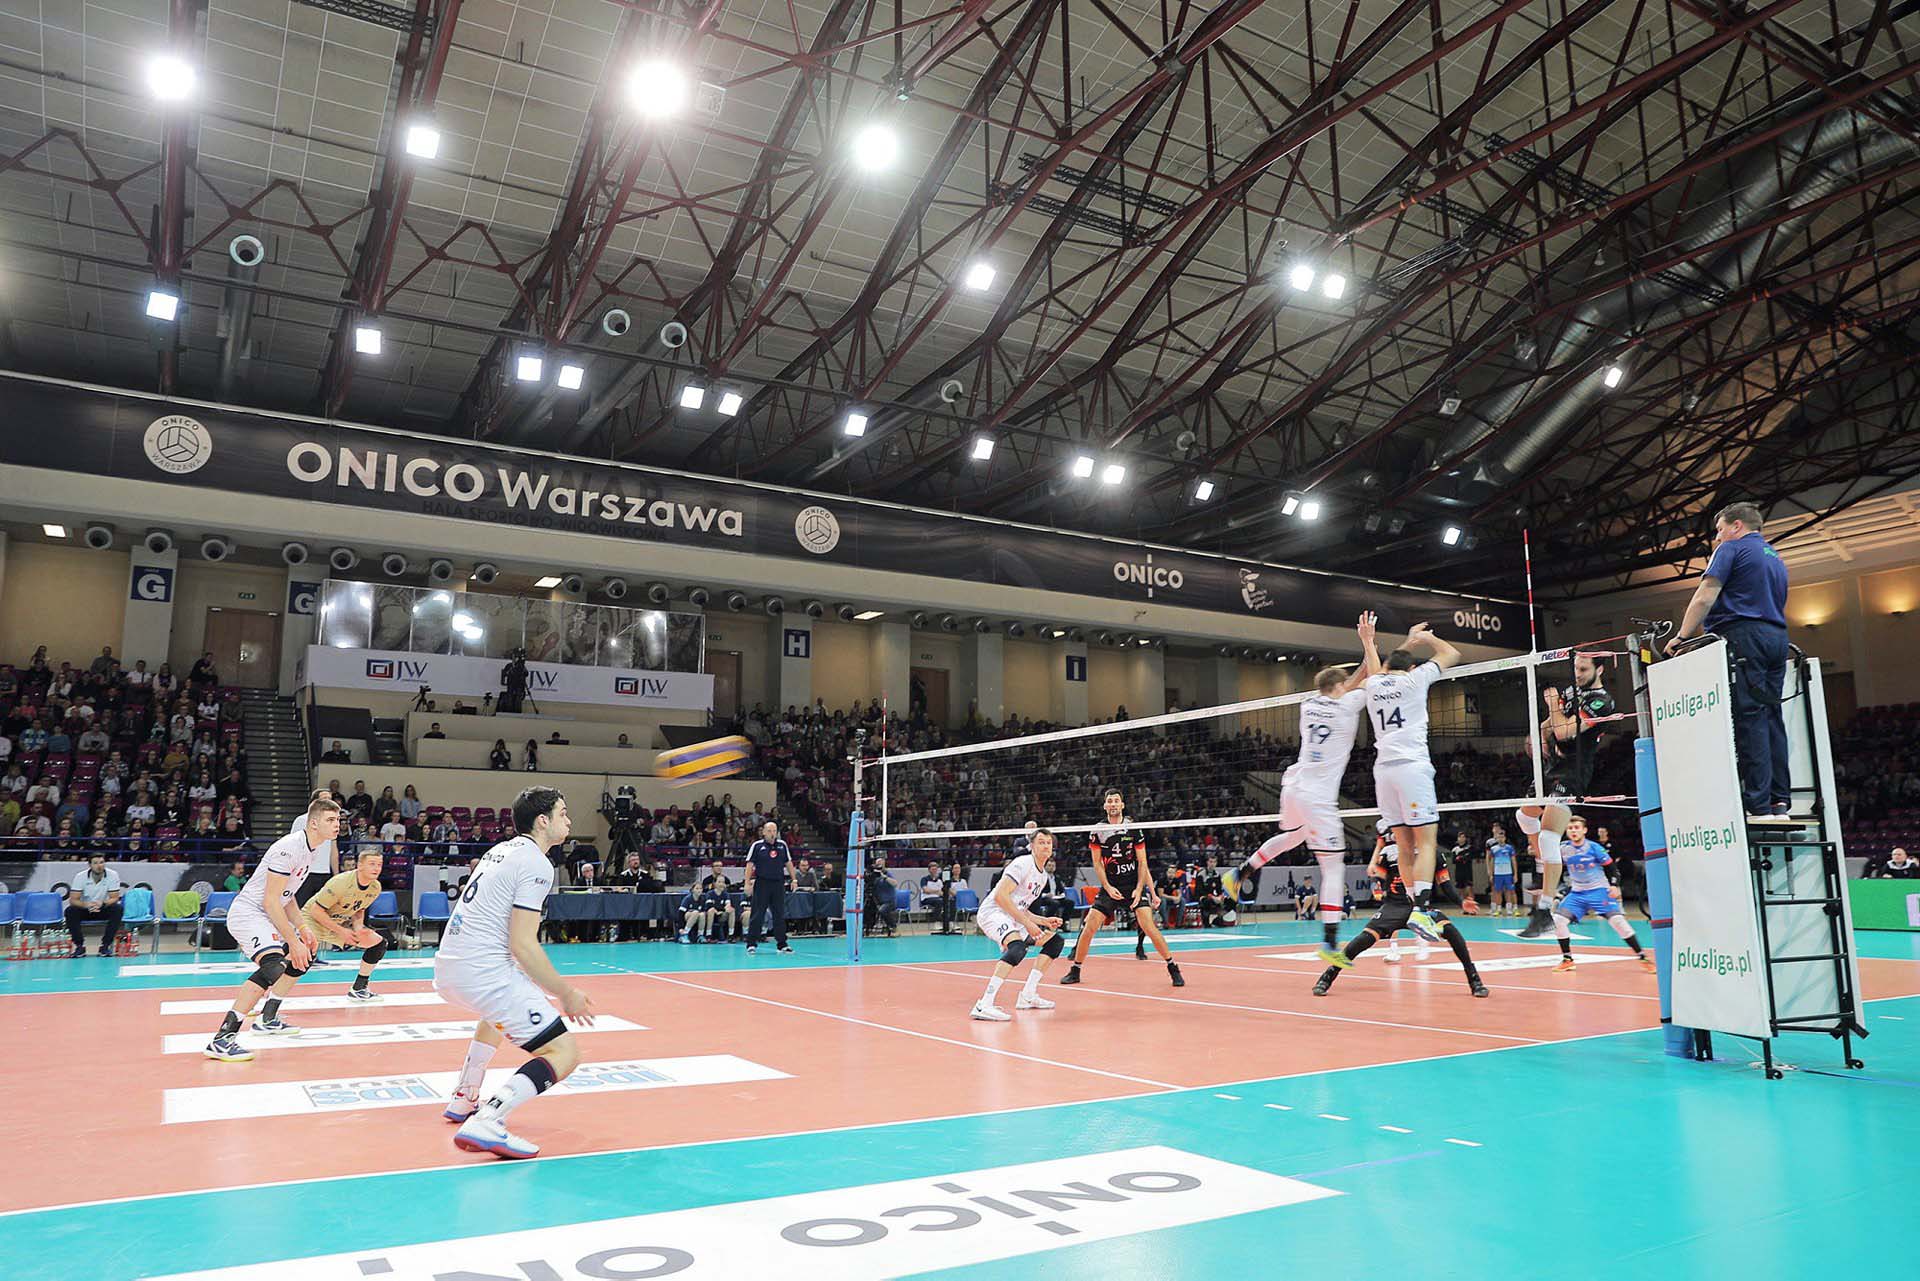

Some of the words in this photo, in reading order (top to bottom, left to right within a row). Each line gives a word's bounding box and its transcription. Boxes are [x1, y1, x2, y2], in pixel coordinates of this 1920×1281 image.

[162, 418, 199, 431] ONICO
[287, 442, 485, 502] ONICO
[497, 468, 743, 537] Warszawa
[137, 573, 166, 600] G
[1113, 553, 1184, 598] ONICO
[1453, 603, 1502, 640] ONICO
[788, 634, 806, 656] H
[1541, 650, 1569, 662] netex
[397, 660, 429, 681] JW
[529, 670, 558, 689] JW
[640, 678, 669, 697] JW
[1655, 683, 1720, 727] plusliga.pl
[1376, 706, 1406, 731] 14
[1308, 723, 1332, 744] 19
[1111, 842, 1122, 854] 4
[1670, 822, 1737, 853] plusliga.pl
[1116, 862, 1136, 875] JSW
[462, 872, 484, 904] 6
[997, 923, 1009, 936] 20
[251, 936, 261, 949] 2
[1677, 947, 1753, 977] plusliga.pl
[779, 1171, 1203, 1248] ONICO
